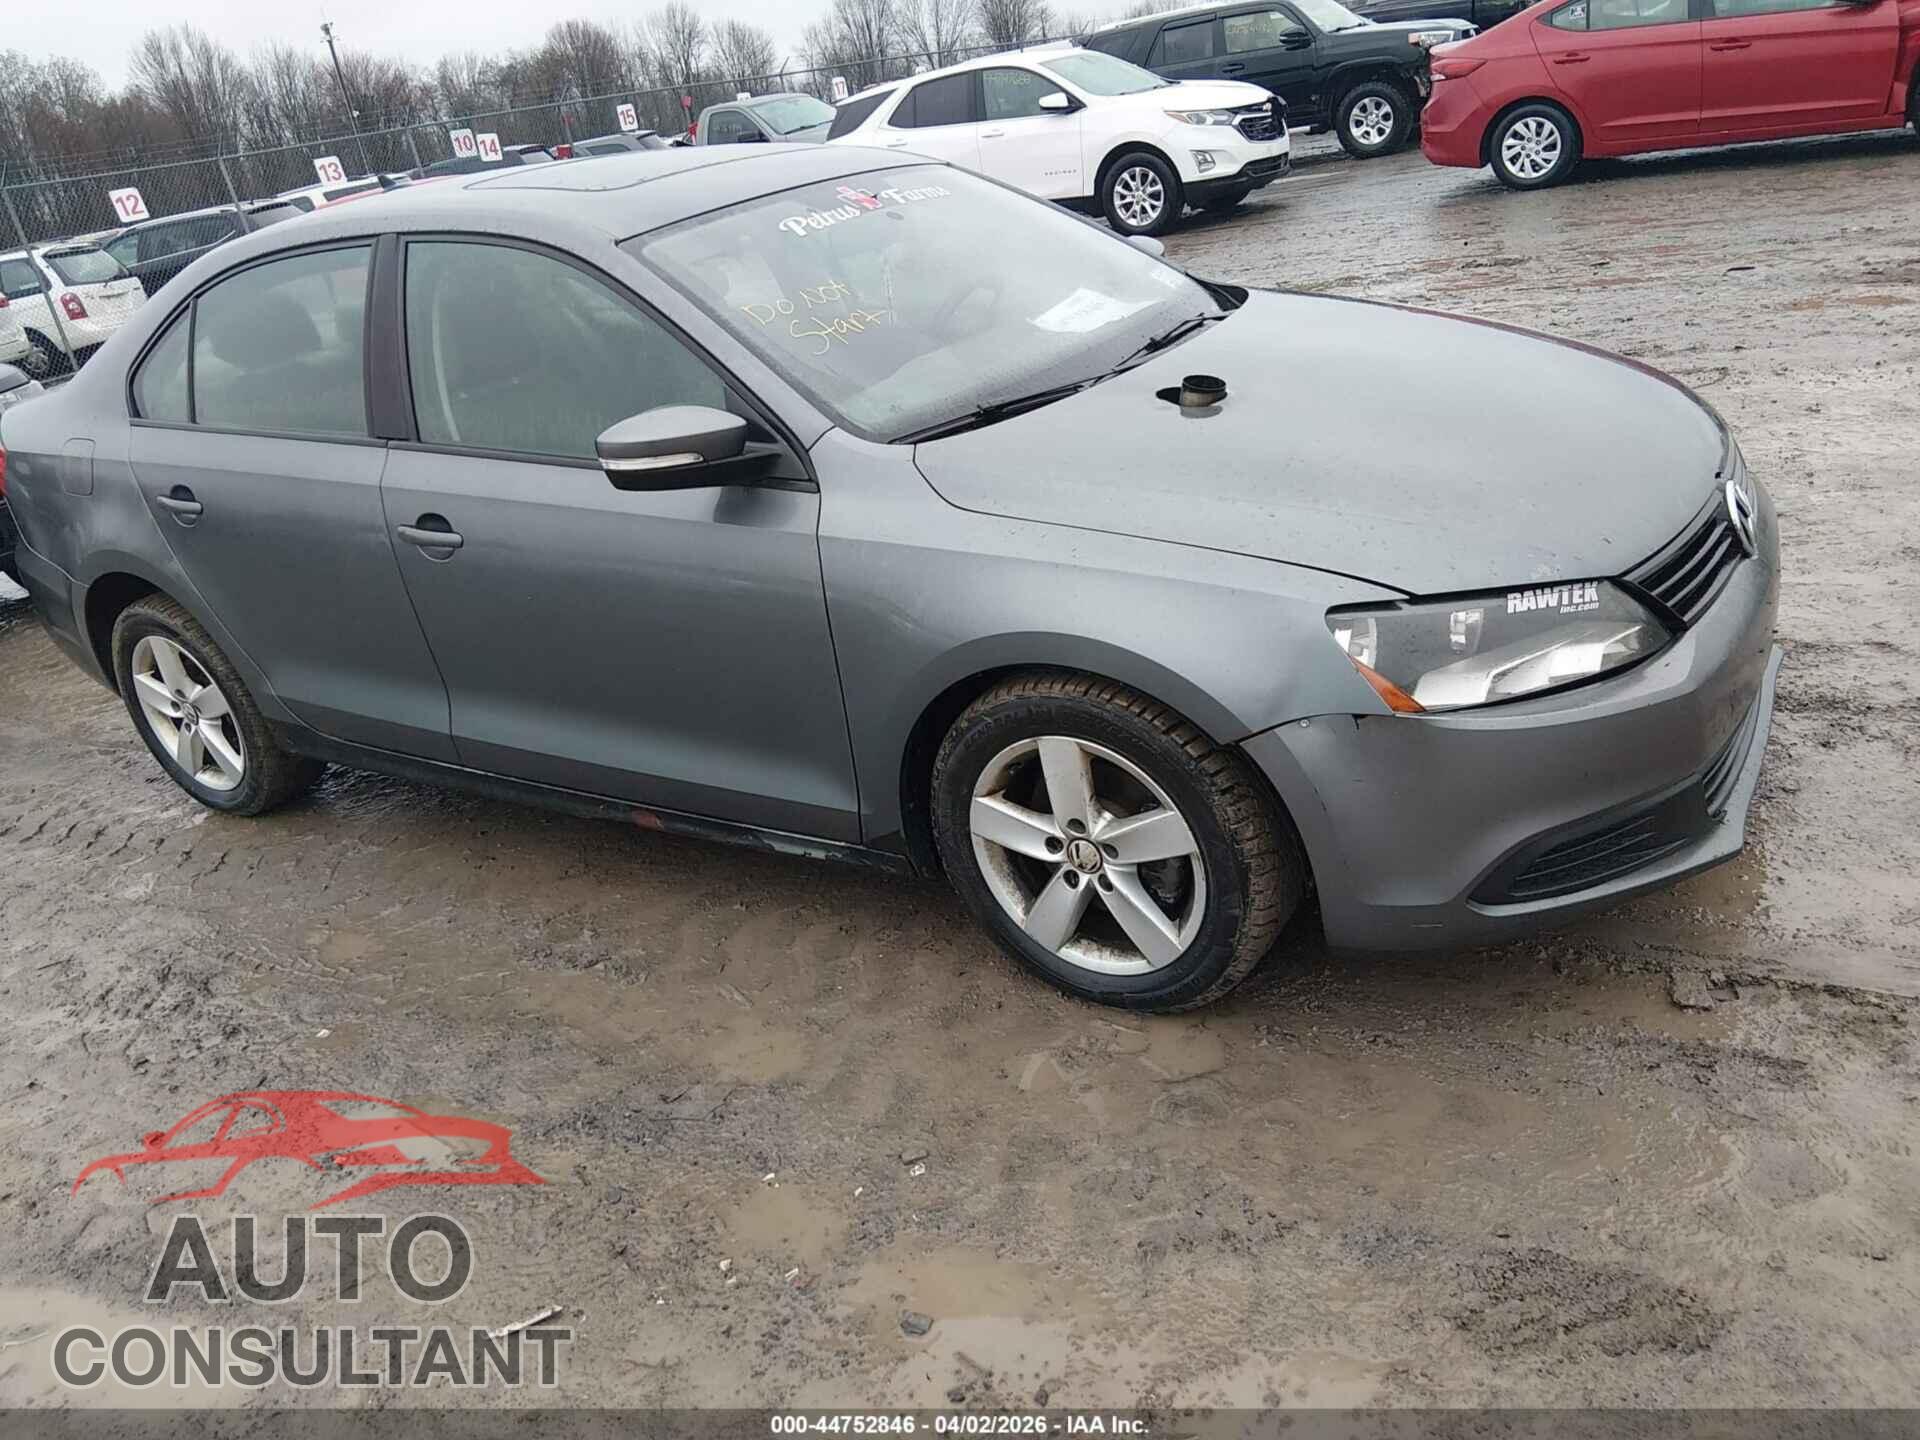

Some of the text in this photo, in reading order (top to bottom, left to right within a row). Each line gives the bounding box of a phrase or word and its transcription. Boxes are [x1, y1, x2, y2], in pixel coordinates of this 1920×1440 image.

[619, 108, 635, 127] 15
[454, 134, 474, 152] 10
[479, 138, 499, 157] 14
[318, 161, 342, 182] 13
[115, 193, 145, 218] 12
[778, 204, 861, 237] Petrus
[790, 309, 887, 356] Start
[1507, 581, 1598, 614] RAWTEK
